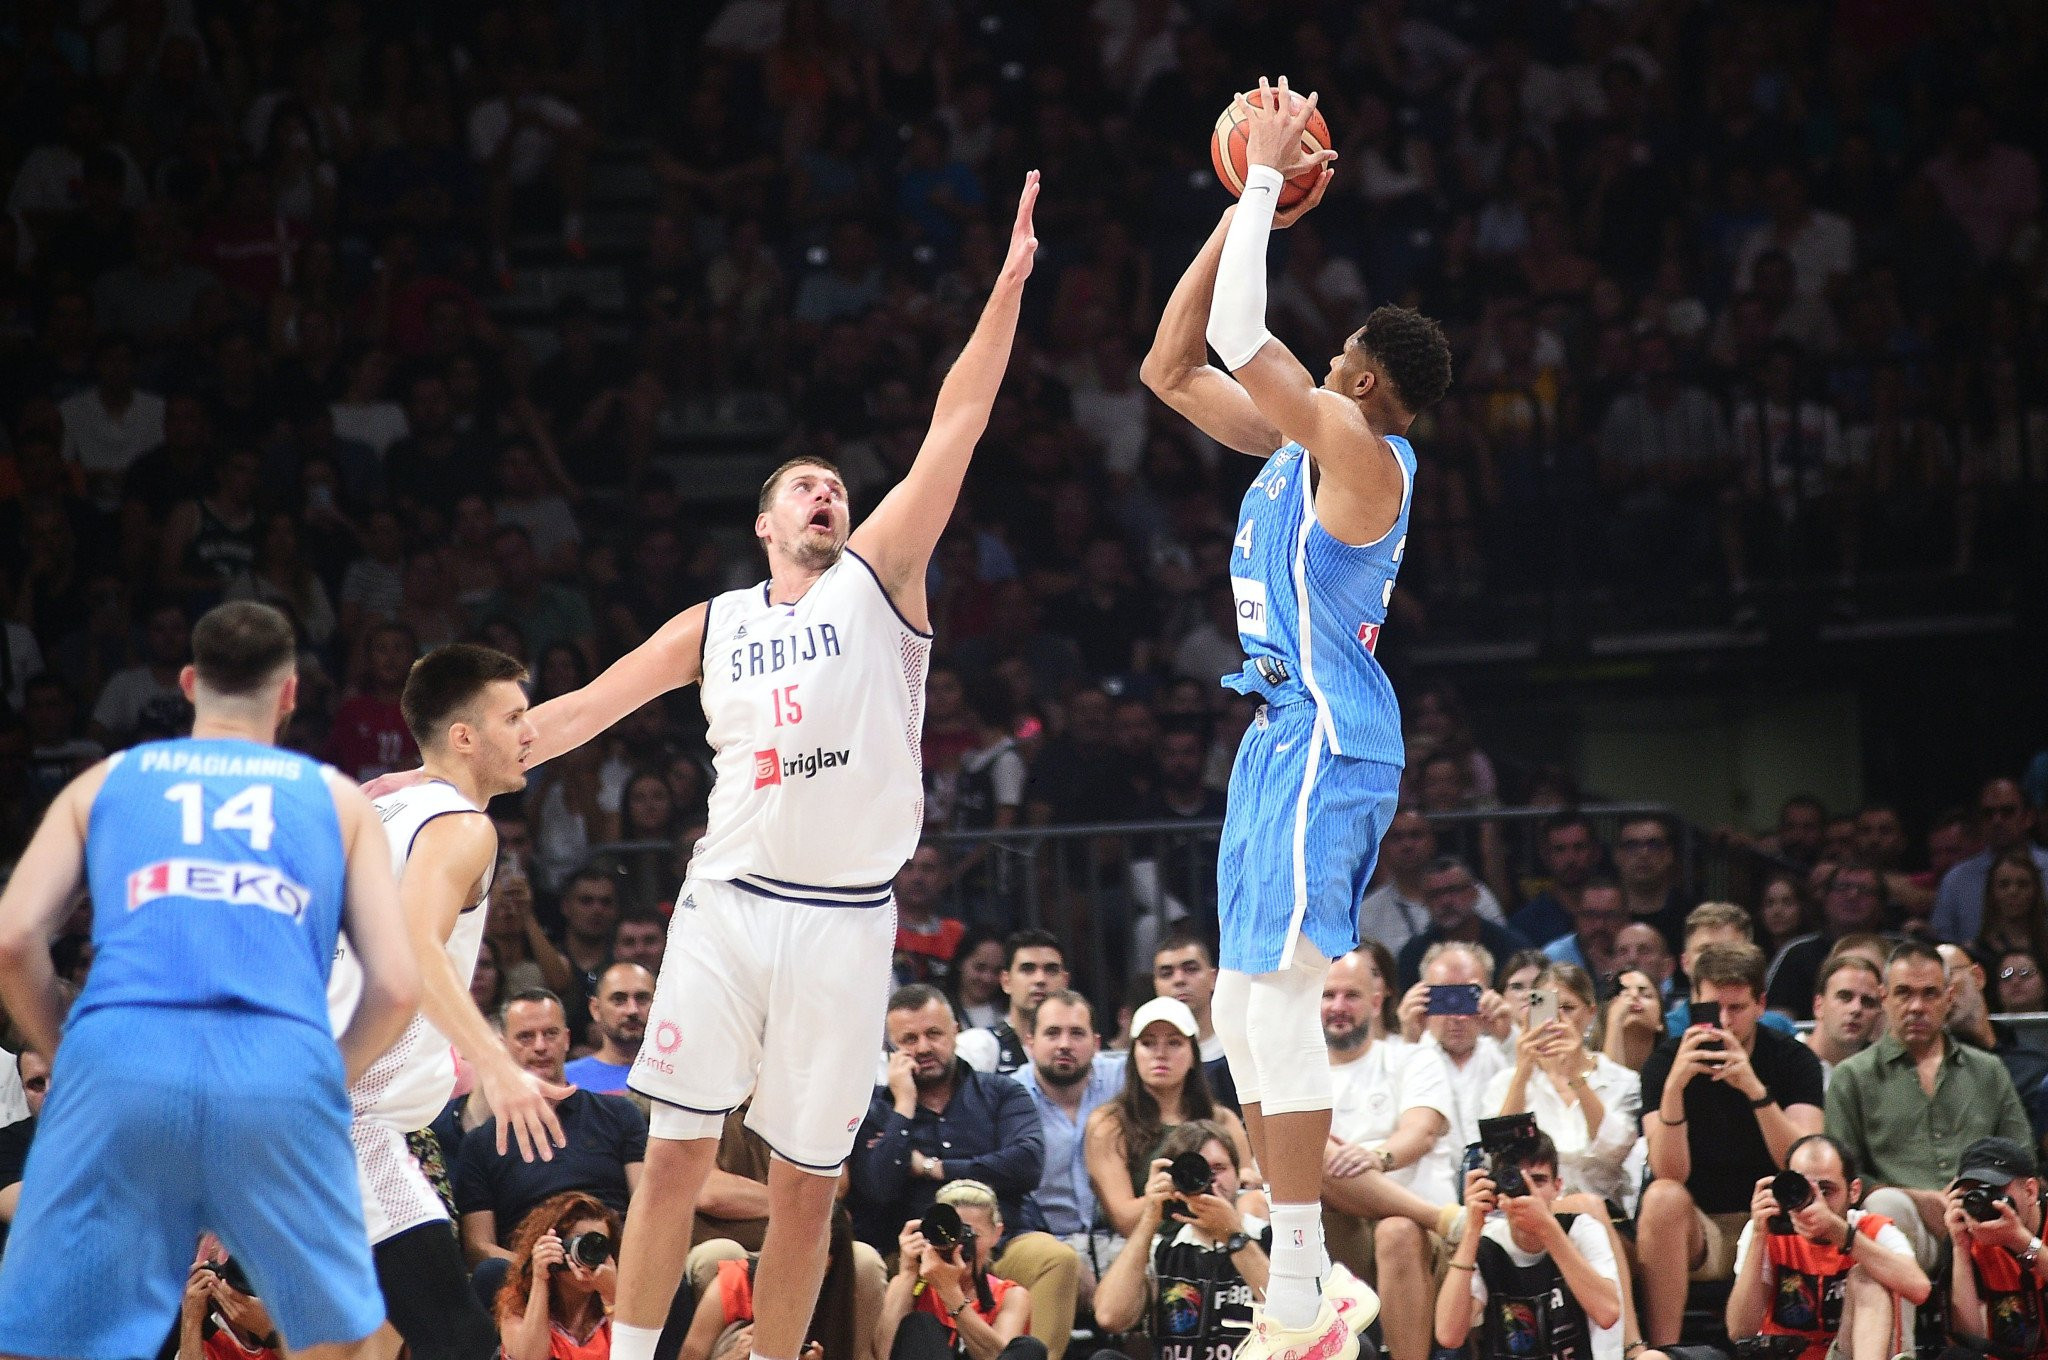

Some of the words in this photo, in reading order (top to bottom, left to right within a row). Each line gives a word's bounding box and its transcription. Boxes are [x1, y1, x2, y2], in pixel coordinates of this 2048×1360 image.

[1235, 598, 1265, 623] an
[731, 623, 841, 683] SRBIJA
[771, 684, 803, 728] 15
[140, 750, 301, 781] PAPAGIANNIS
[783, 747, 850, 779] triglav
[163, 781, 276, 851] 14
[186, 867, 302, 918] EKO
[646, 1057, 675, 1075] mts
